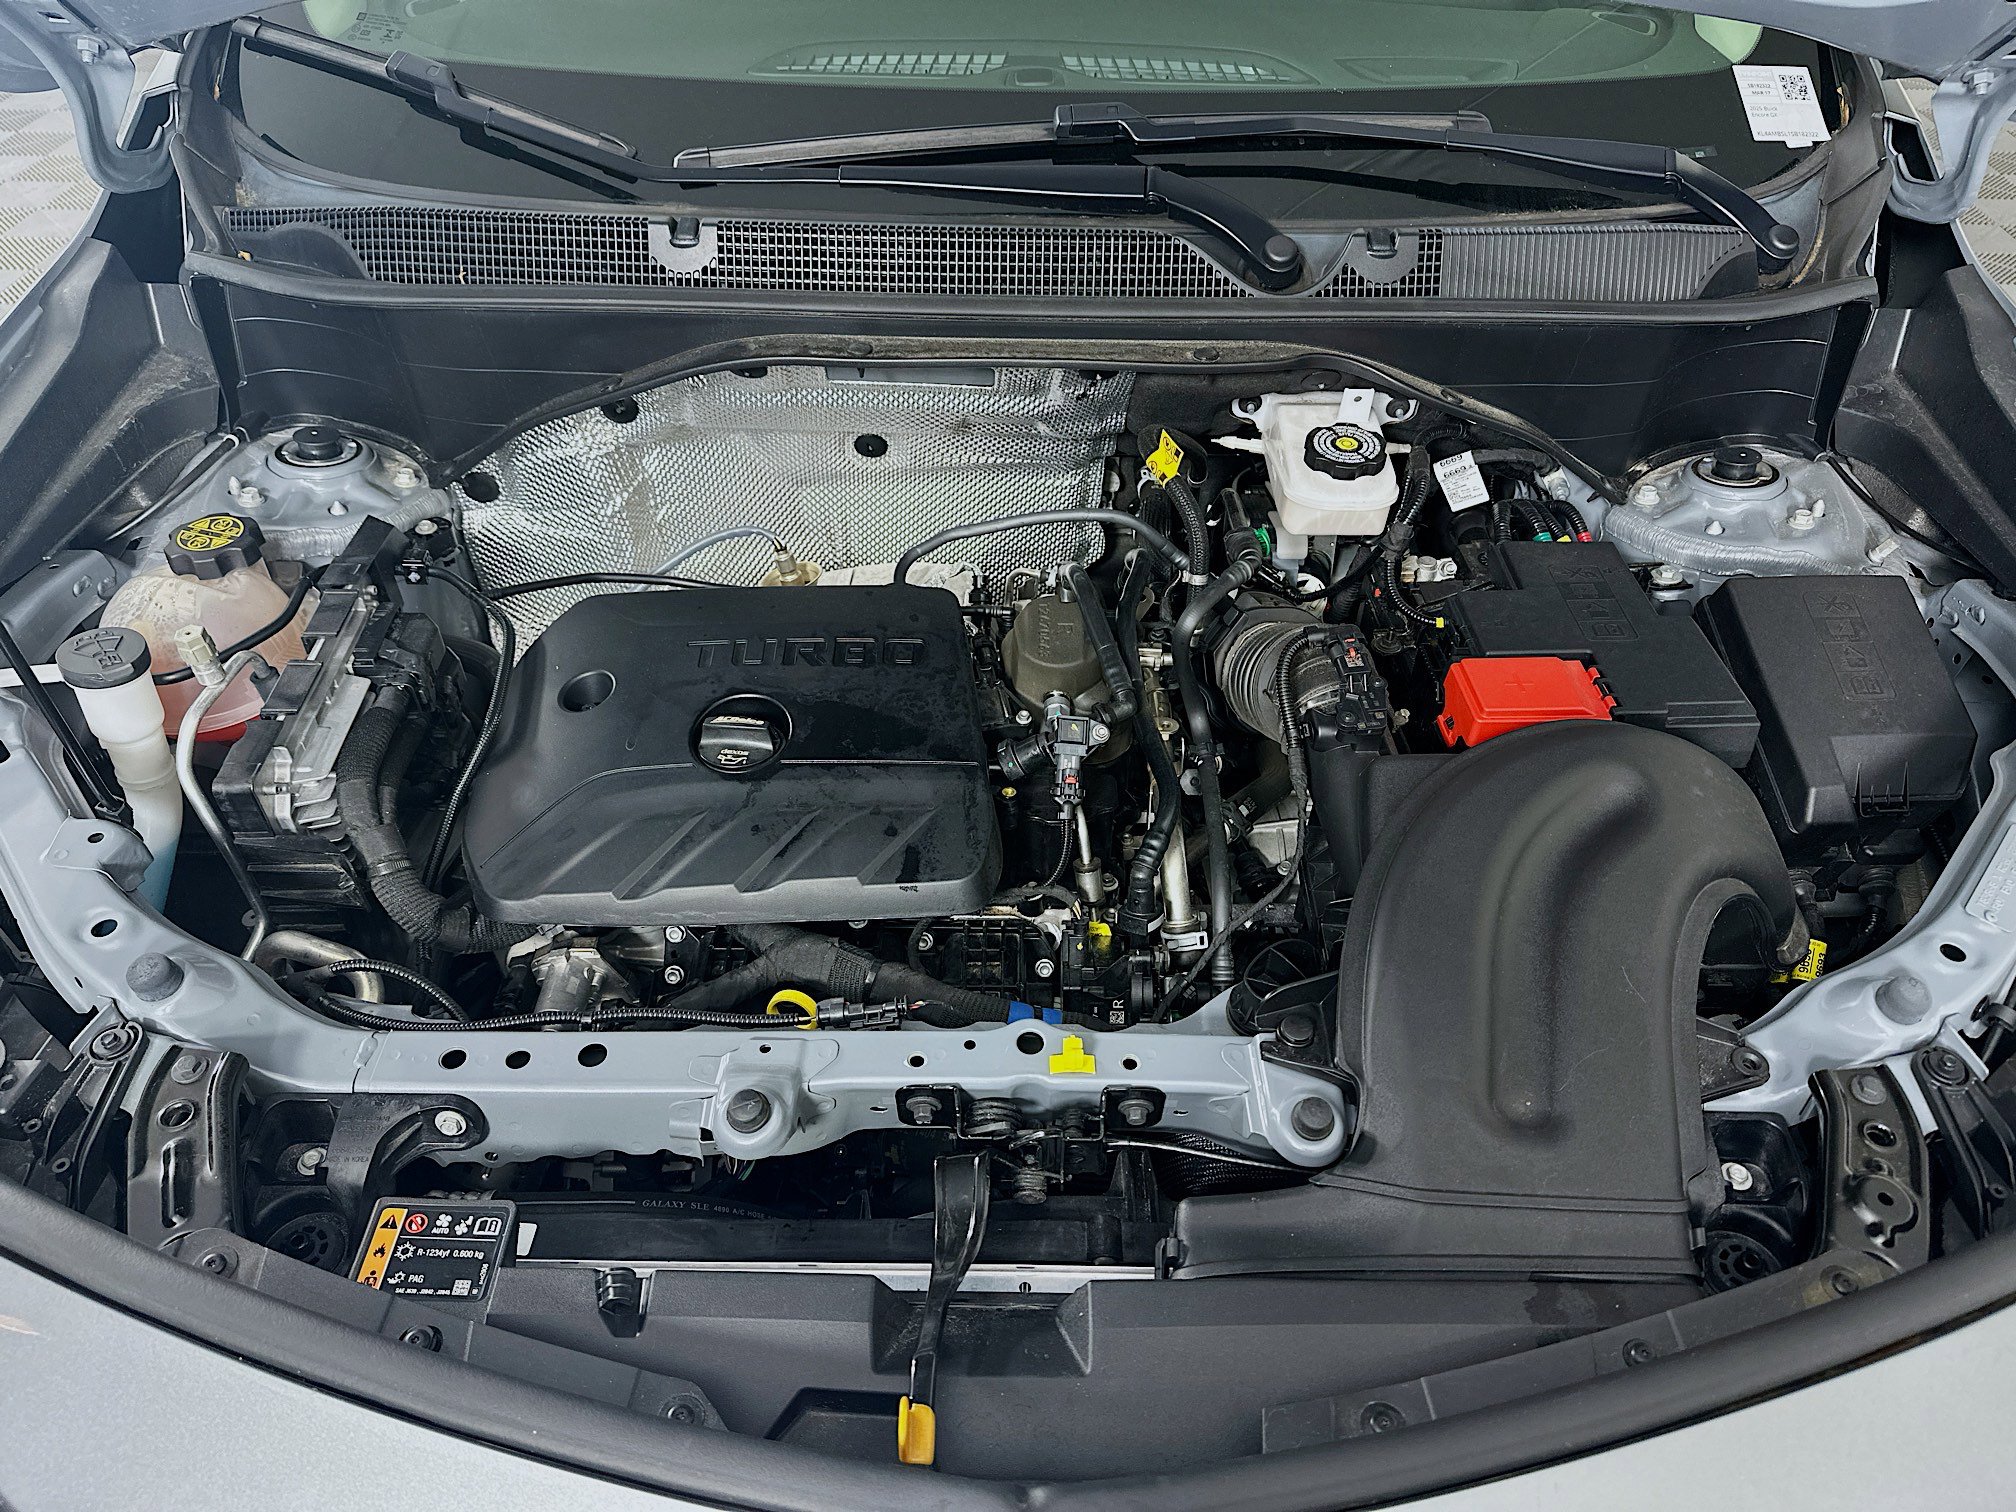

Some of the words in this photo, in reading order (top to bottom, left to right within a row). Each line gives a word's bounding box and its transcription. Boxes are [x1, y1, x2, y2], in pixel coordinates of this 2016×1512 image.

[687, 637, 925, 668] TURBO
[720, 748, 750, 756] dexos
[642, 1199, 686, 1209] GALAXY
[690, 1202, 710, 1211] SLE
[732, 1208, 745, 1216] A/C
[431, 1226, 450, 1235] AUTO
[416, 1247, 451, 1258] R-1234yf
[453, 1249, 474, 1258] 0.600
[474, 1249, 485, 1260] kg
[408, 1274, 425, 1284] PAG
